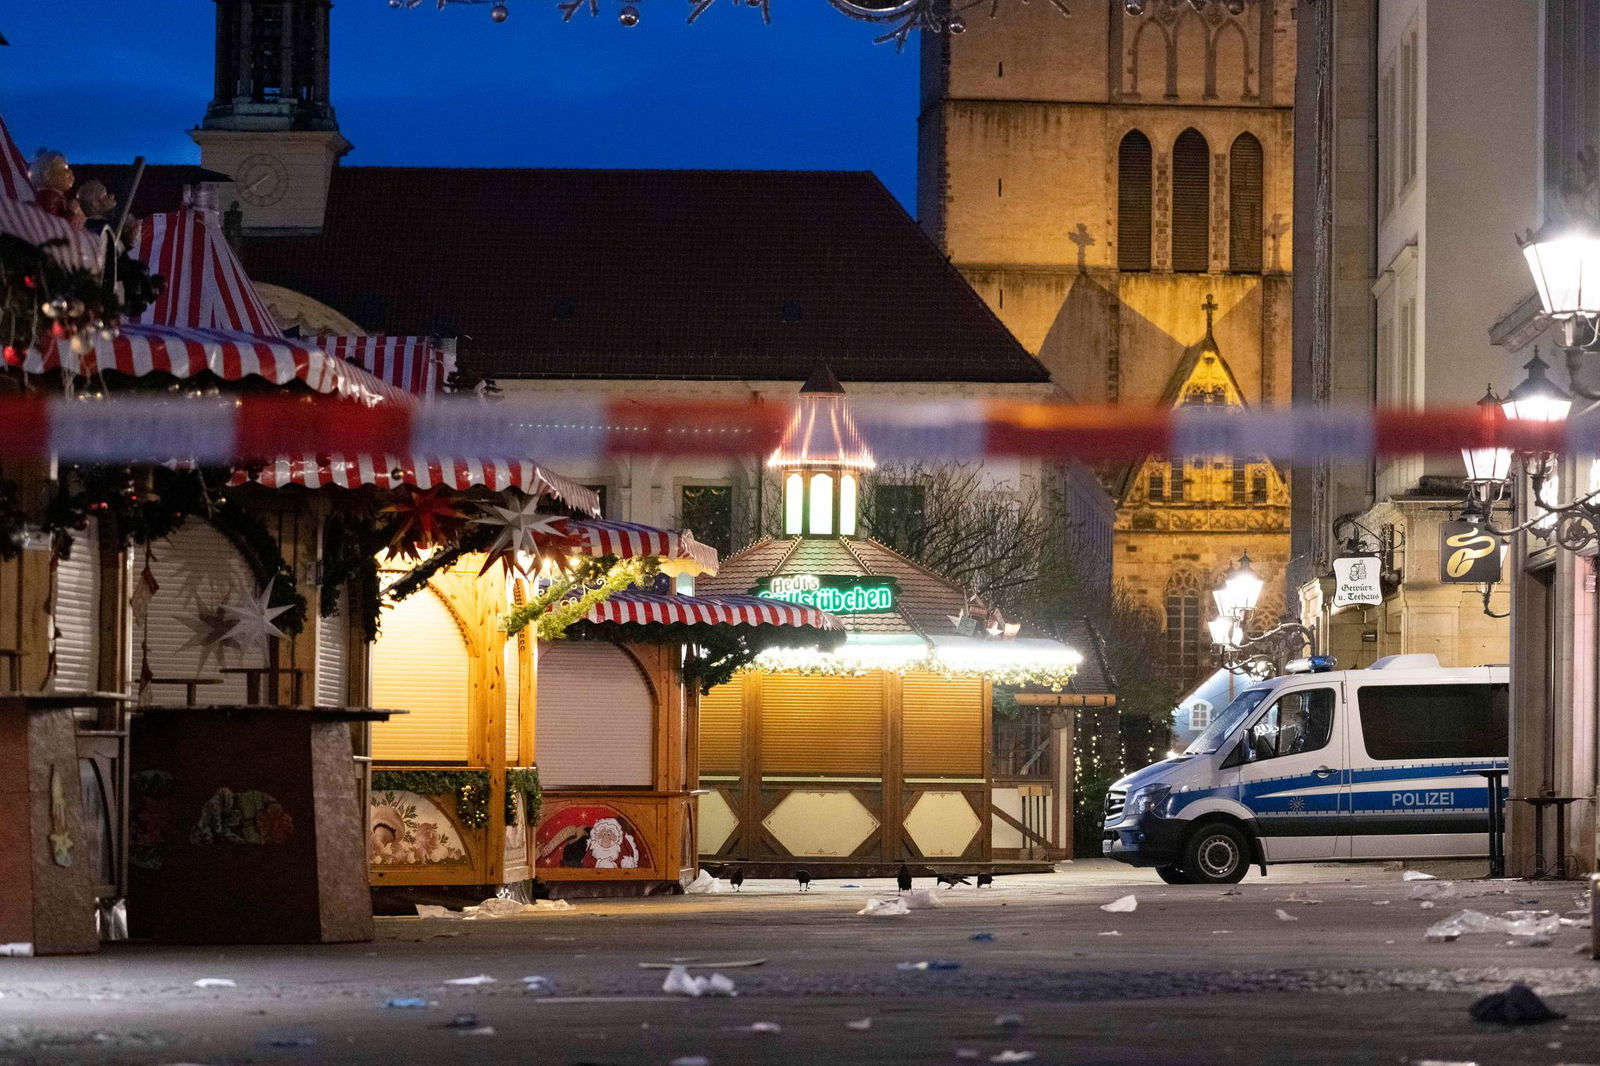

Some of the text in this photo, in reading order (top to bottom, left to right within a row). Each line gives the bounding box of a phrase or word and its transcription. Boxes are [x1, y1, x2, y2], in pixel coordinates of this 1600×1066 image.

[759, 586, 892, 612] llstübchen
[1347, 592, 1380, 601] Teehaus
[1392, 792, 1455, 806] POLIZEI
